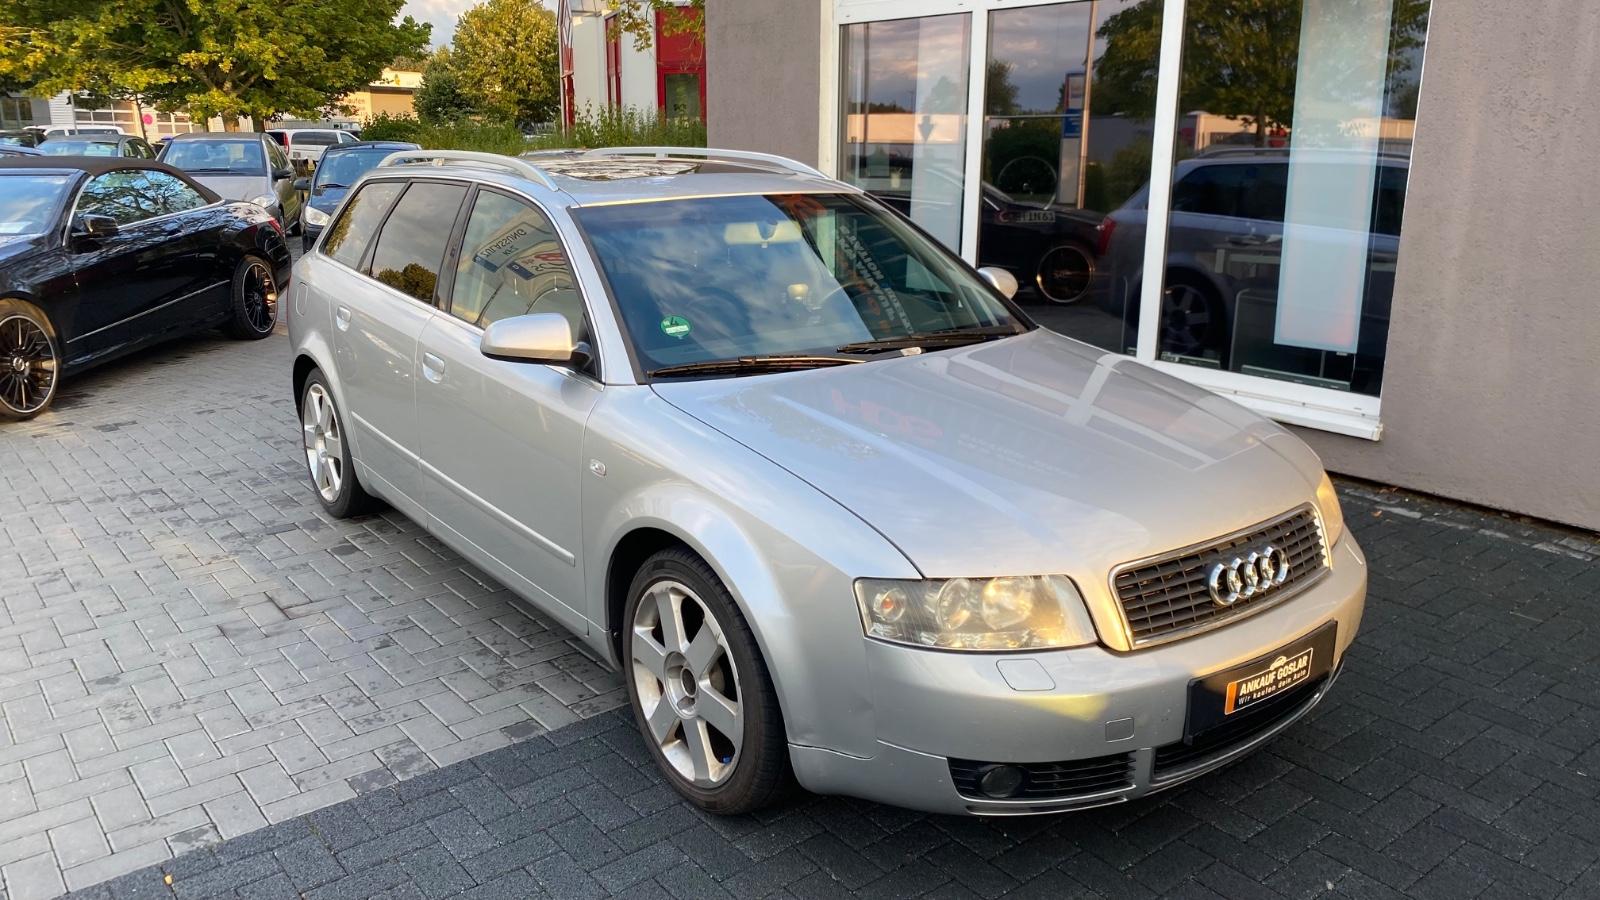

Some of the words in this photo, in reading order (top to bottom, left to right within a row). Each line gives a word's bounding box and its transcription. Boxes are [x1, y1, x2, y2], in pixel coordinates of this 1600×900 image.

[1238, 695, 1251, 705] Wir
[1253, 685, 1276, 700] kaufen
[1278, 677, 1292, 688] dein
[1293, 669, 1307, 680] Auto
[1239, 671, 1277, 697] ANKAUF
[1277, 655, 1308, 680] GOSLAR
